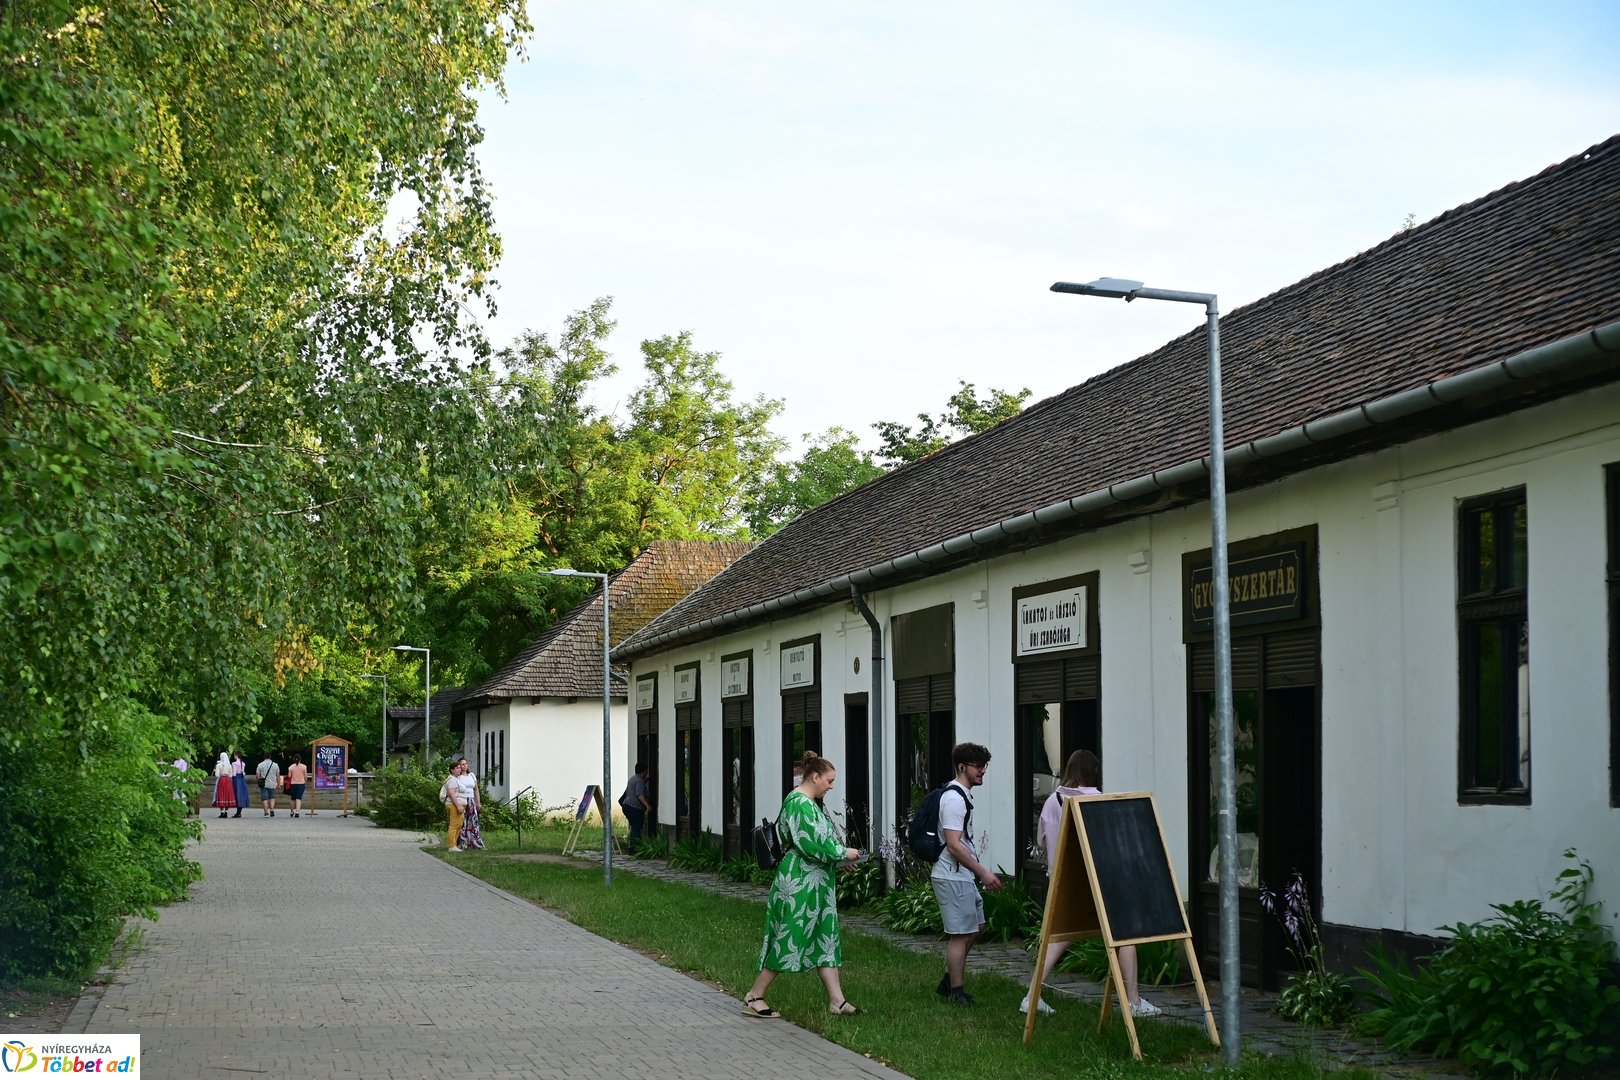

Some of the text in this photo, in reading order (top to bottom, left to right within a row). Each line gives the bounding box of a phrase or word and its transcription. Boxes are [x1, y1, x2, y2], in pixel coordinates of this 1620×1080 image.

[1023, 607, 1047, 624] LAKATOS
[1056, 598, 1076, 619] LÁSZLÓ
[1030, 625, 1071, 647] ÚRI SZABÓSÁGA
